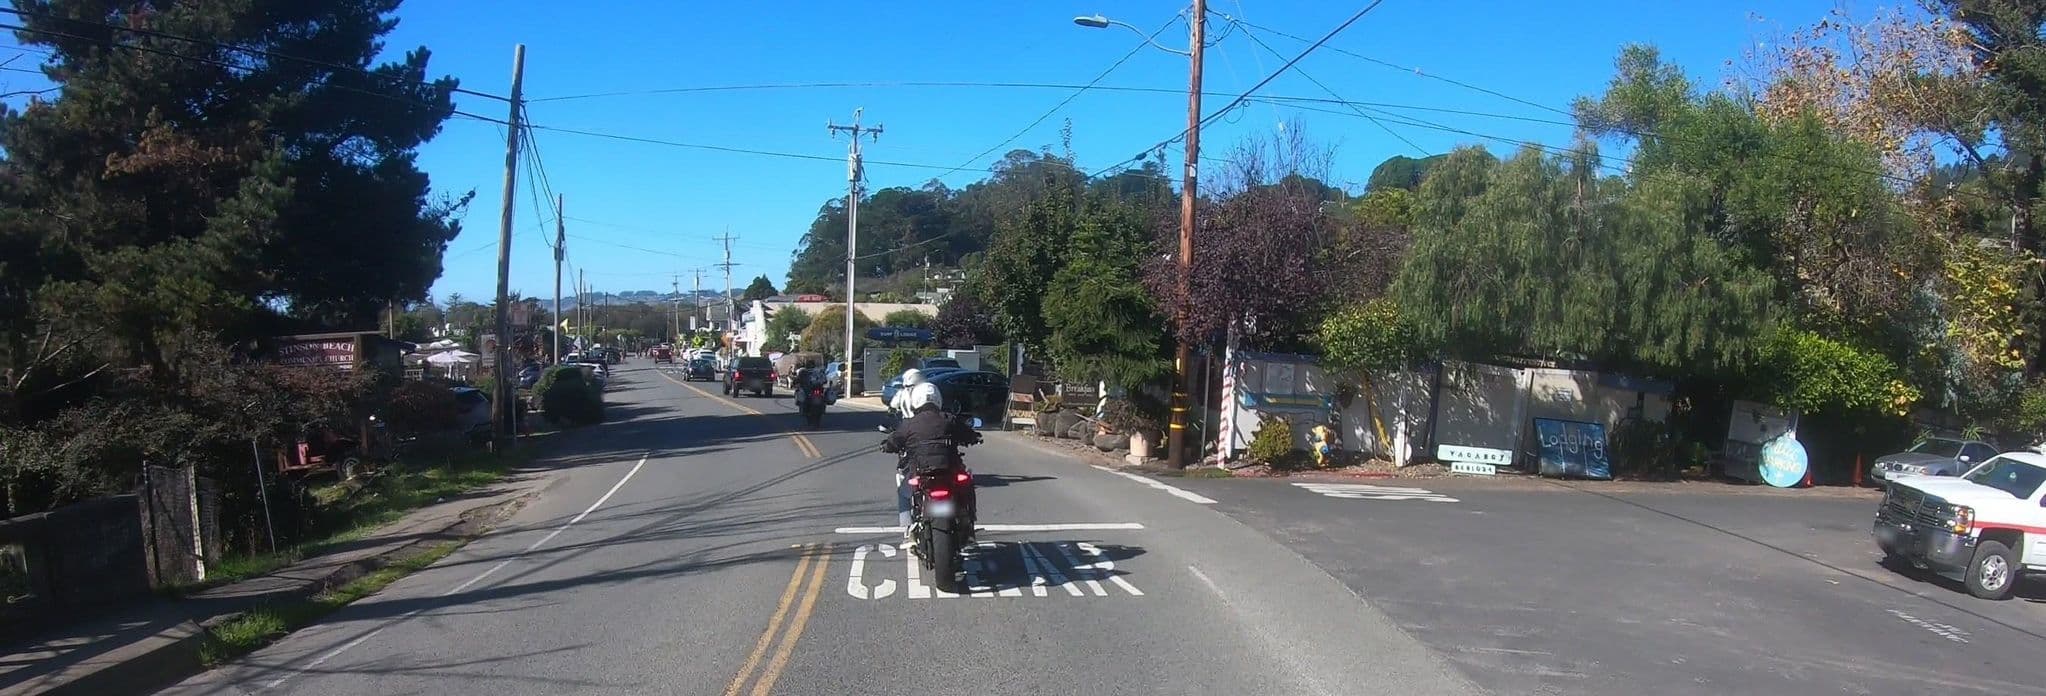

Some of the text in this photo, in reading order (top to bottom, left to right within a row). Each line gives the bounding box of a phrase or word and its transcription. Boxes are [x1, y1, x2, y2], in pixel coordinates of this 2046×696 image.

[279, 342, 355, 355] STINSON BEACH
[325, 354, 354, 362] CHURCH
[1538, 422, 1604, 460] Lodging
[847, 543, 1145, 600] CLEAR
